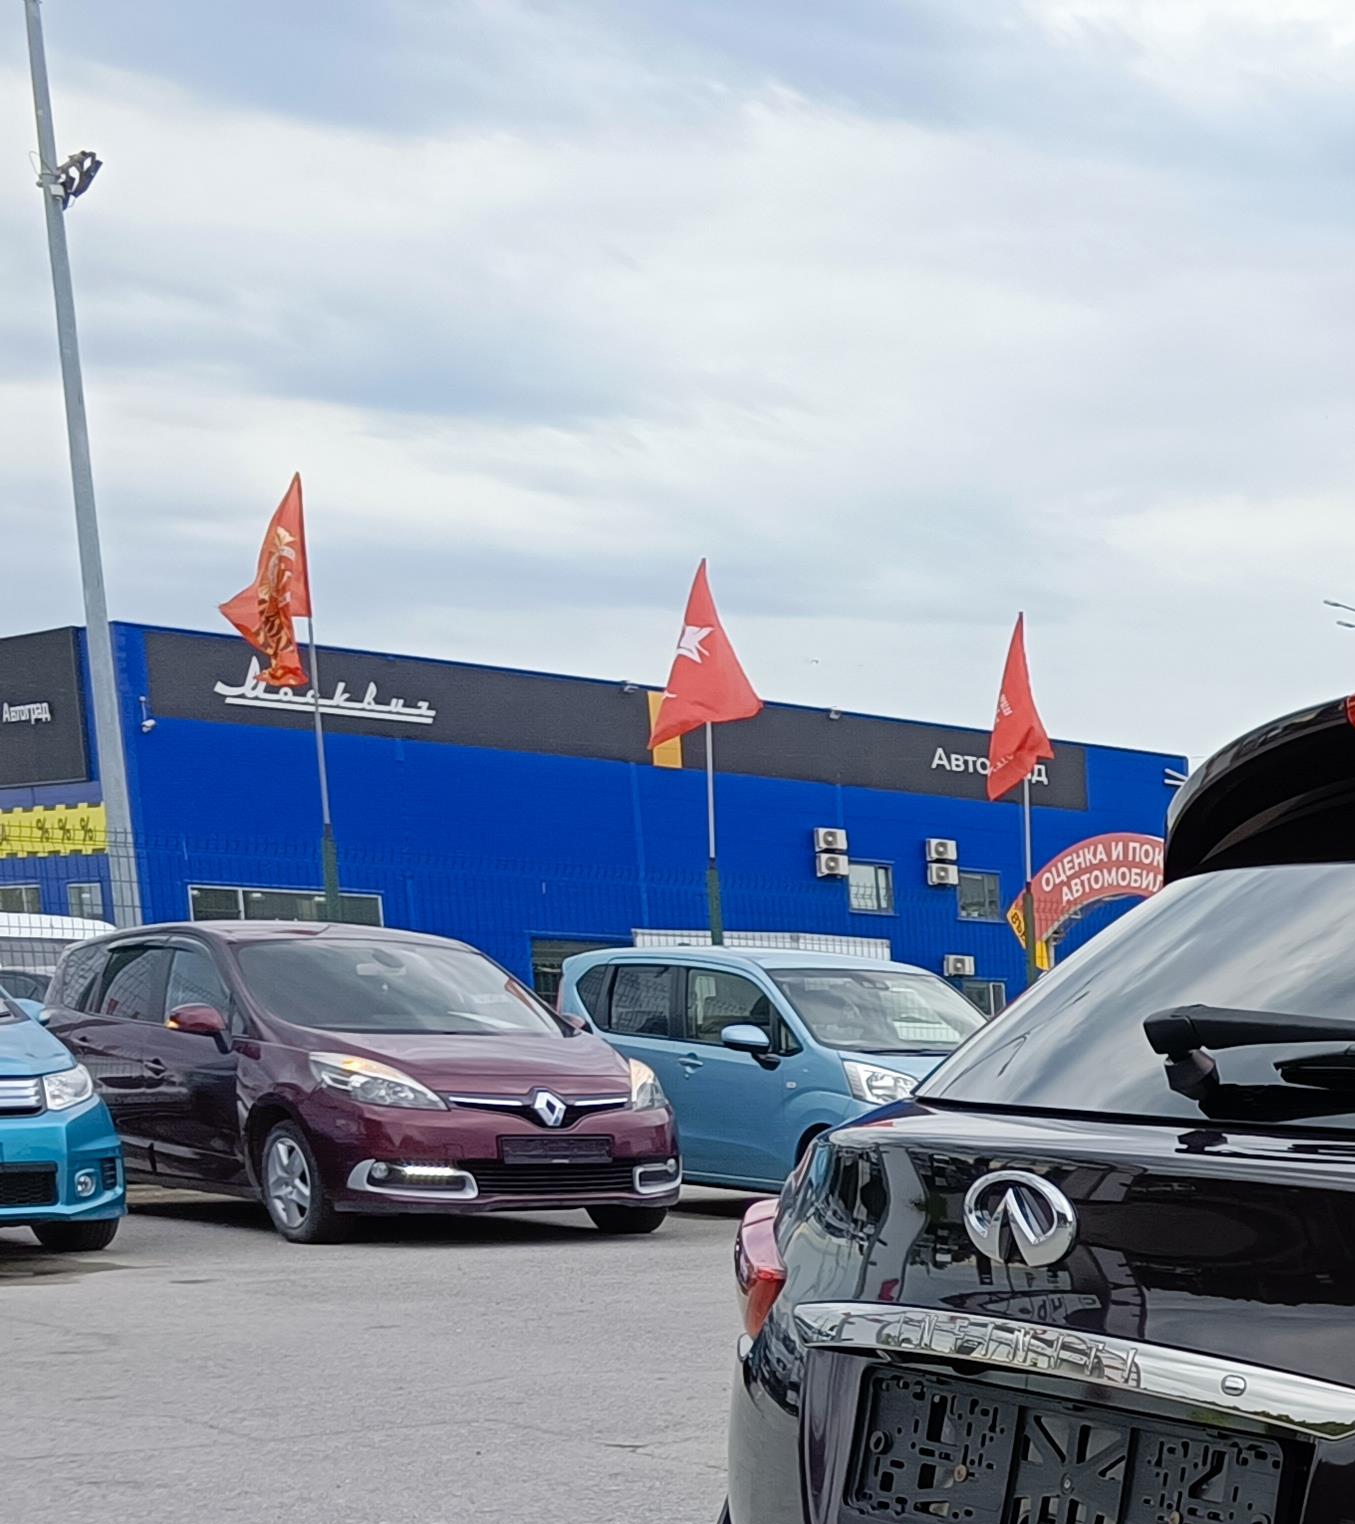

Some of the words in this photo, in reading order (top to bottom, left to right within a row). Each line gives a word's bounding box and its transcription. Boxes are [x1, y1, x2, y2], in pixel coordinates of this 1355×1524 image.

[2, 702, 51, 725] Автоград
[1041, 843, 1107, 893] ОЦЕНКА
[1111, 841, 1123, 861] И
